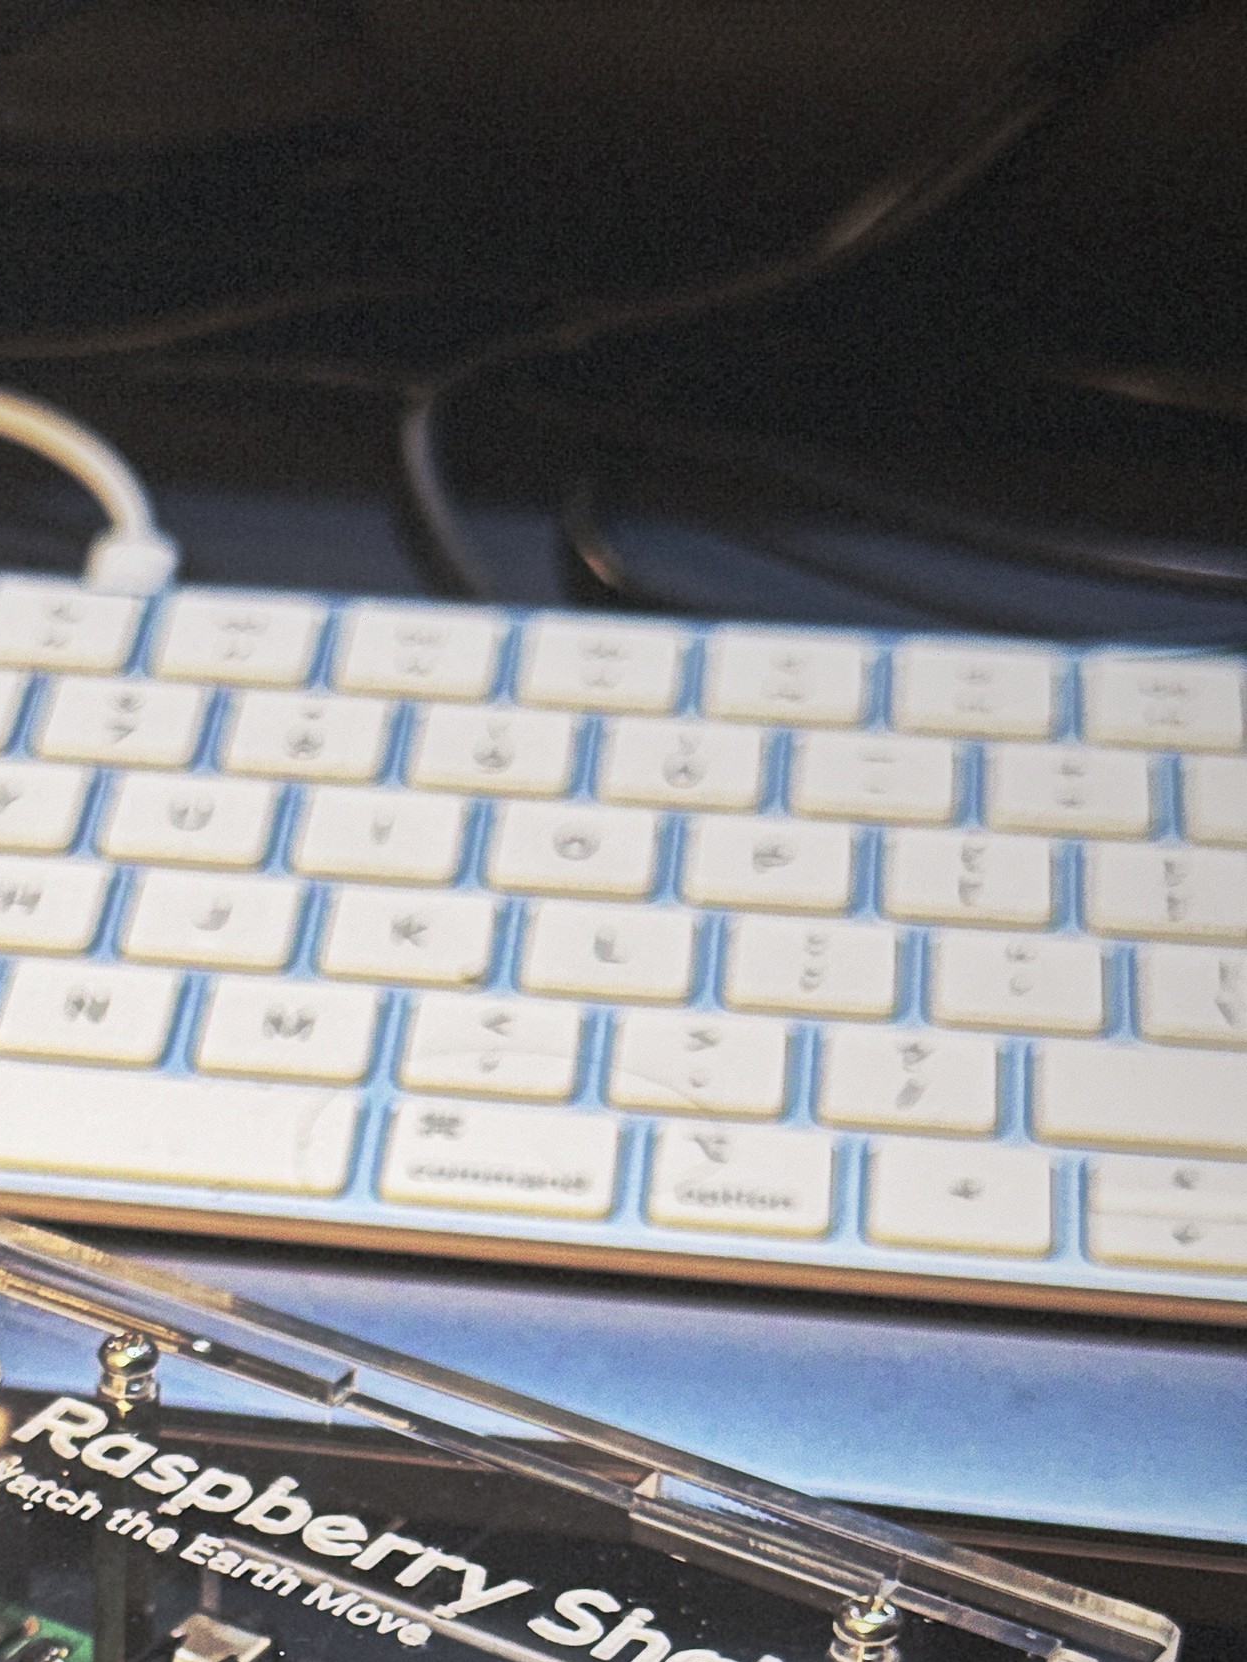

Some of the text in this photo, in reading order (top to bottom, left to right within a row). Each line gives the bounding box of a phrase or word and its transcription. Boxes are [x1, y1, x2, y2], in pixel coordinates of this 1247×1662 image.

[11, 1396, 535, 1619] Raspberry
[105, 1505, 181, 1553] the
[179, 1531, 305, 1598] Earth
[301, 1580, 433, 1648] Move
